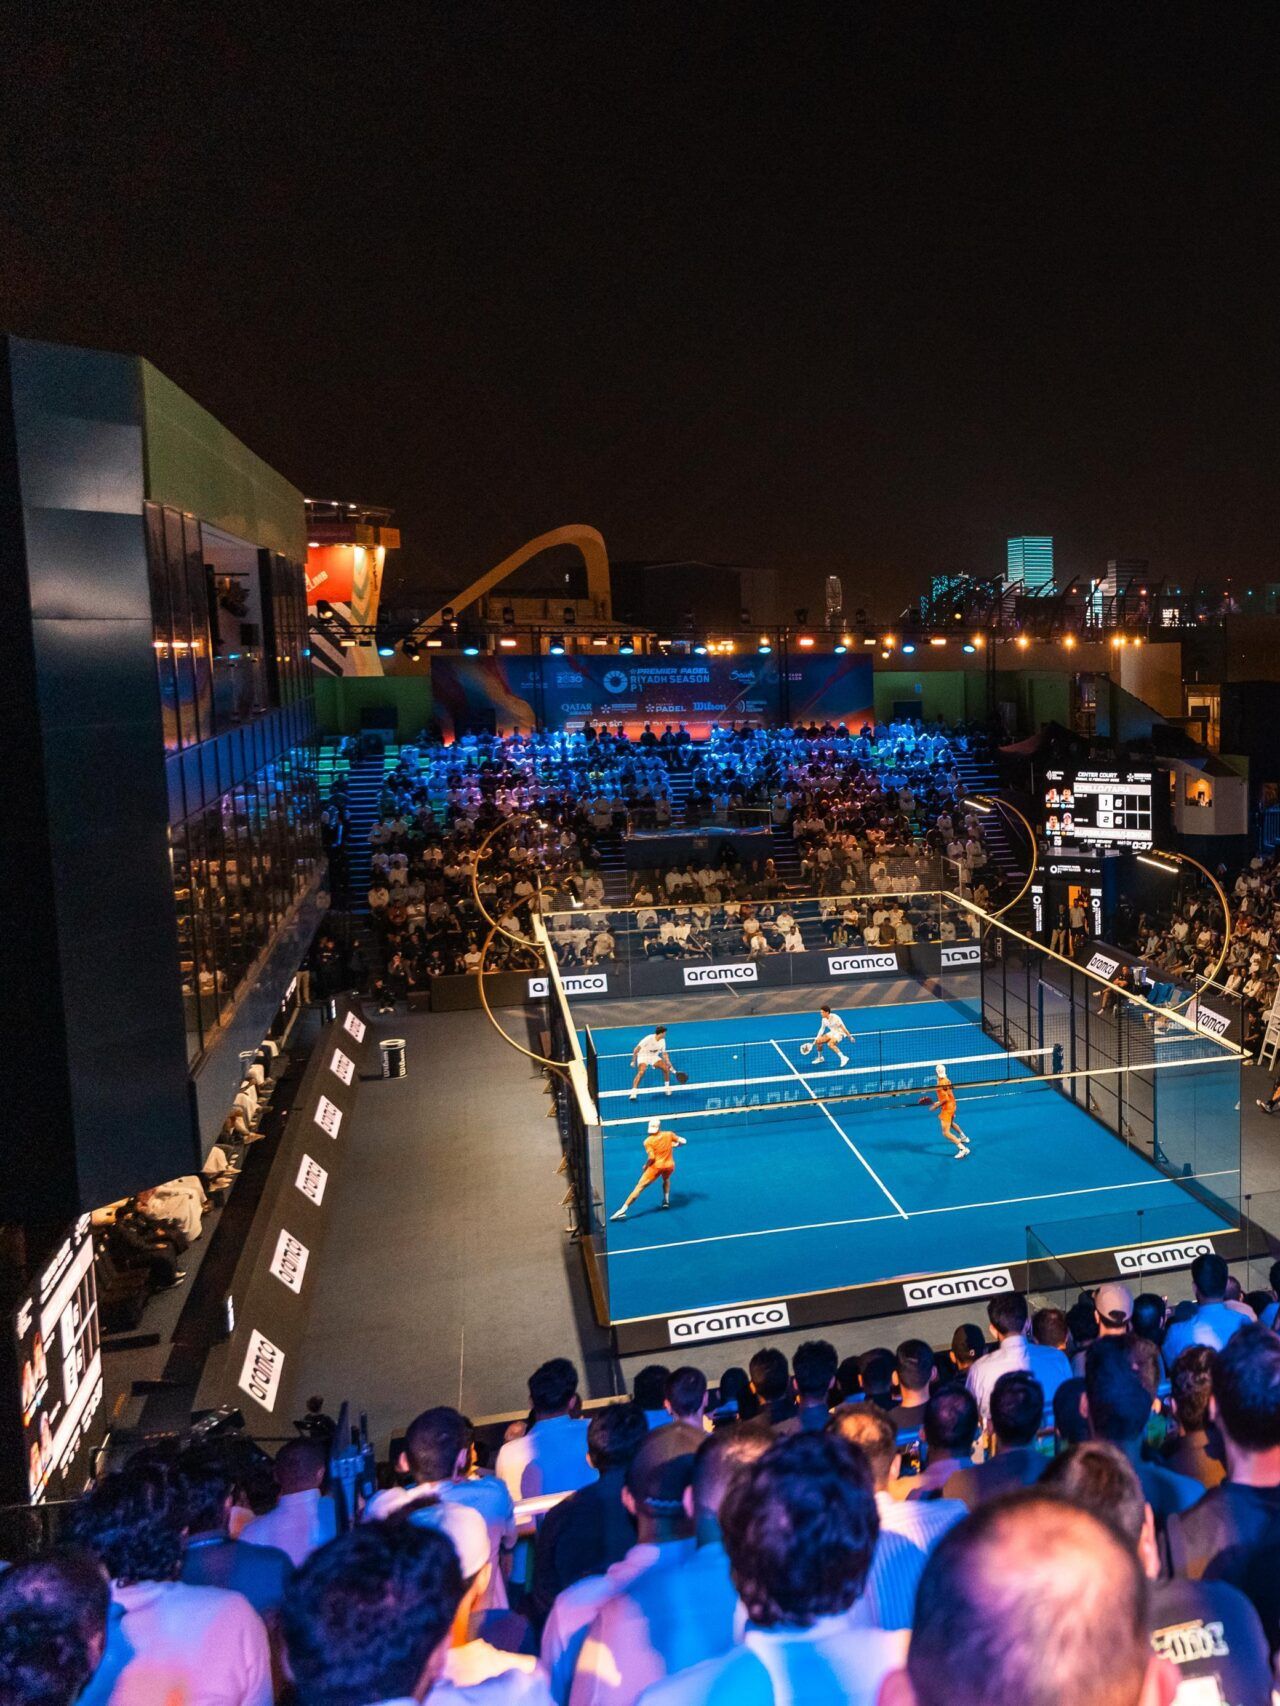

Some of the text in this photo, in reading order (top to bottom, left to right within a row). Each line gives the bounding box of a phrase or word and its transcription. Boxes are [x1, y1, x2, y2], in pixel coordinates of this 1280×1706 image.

[630, 675, 710, 684] RIYADH SEASON
[561, 704, 592, 712] QATAR
[693, 702, 727, 711] Wilson
[1103, 816, 1110, 824] 2
[1131, 841, 1153, 850] 0:37
[832, 957, 895, 971] aramco
[1090, 956, 1115, 975] aramco
[687, 967, 755, 981] aramco
[532, 978, 604, 993] amco
[303, 1161, 322, 1198] aramco
[279, 1238, 302, 1285] aramco
[1120, 1245, 1211, 1268] aramco
[909, 1272, 1008, 1301] aramco
[674, 1307, 784, 1338] aramco
[249, 1340, 277, 1401] aramco
